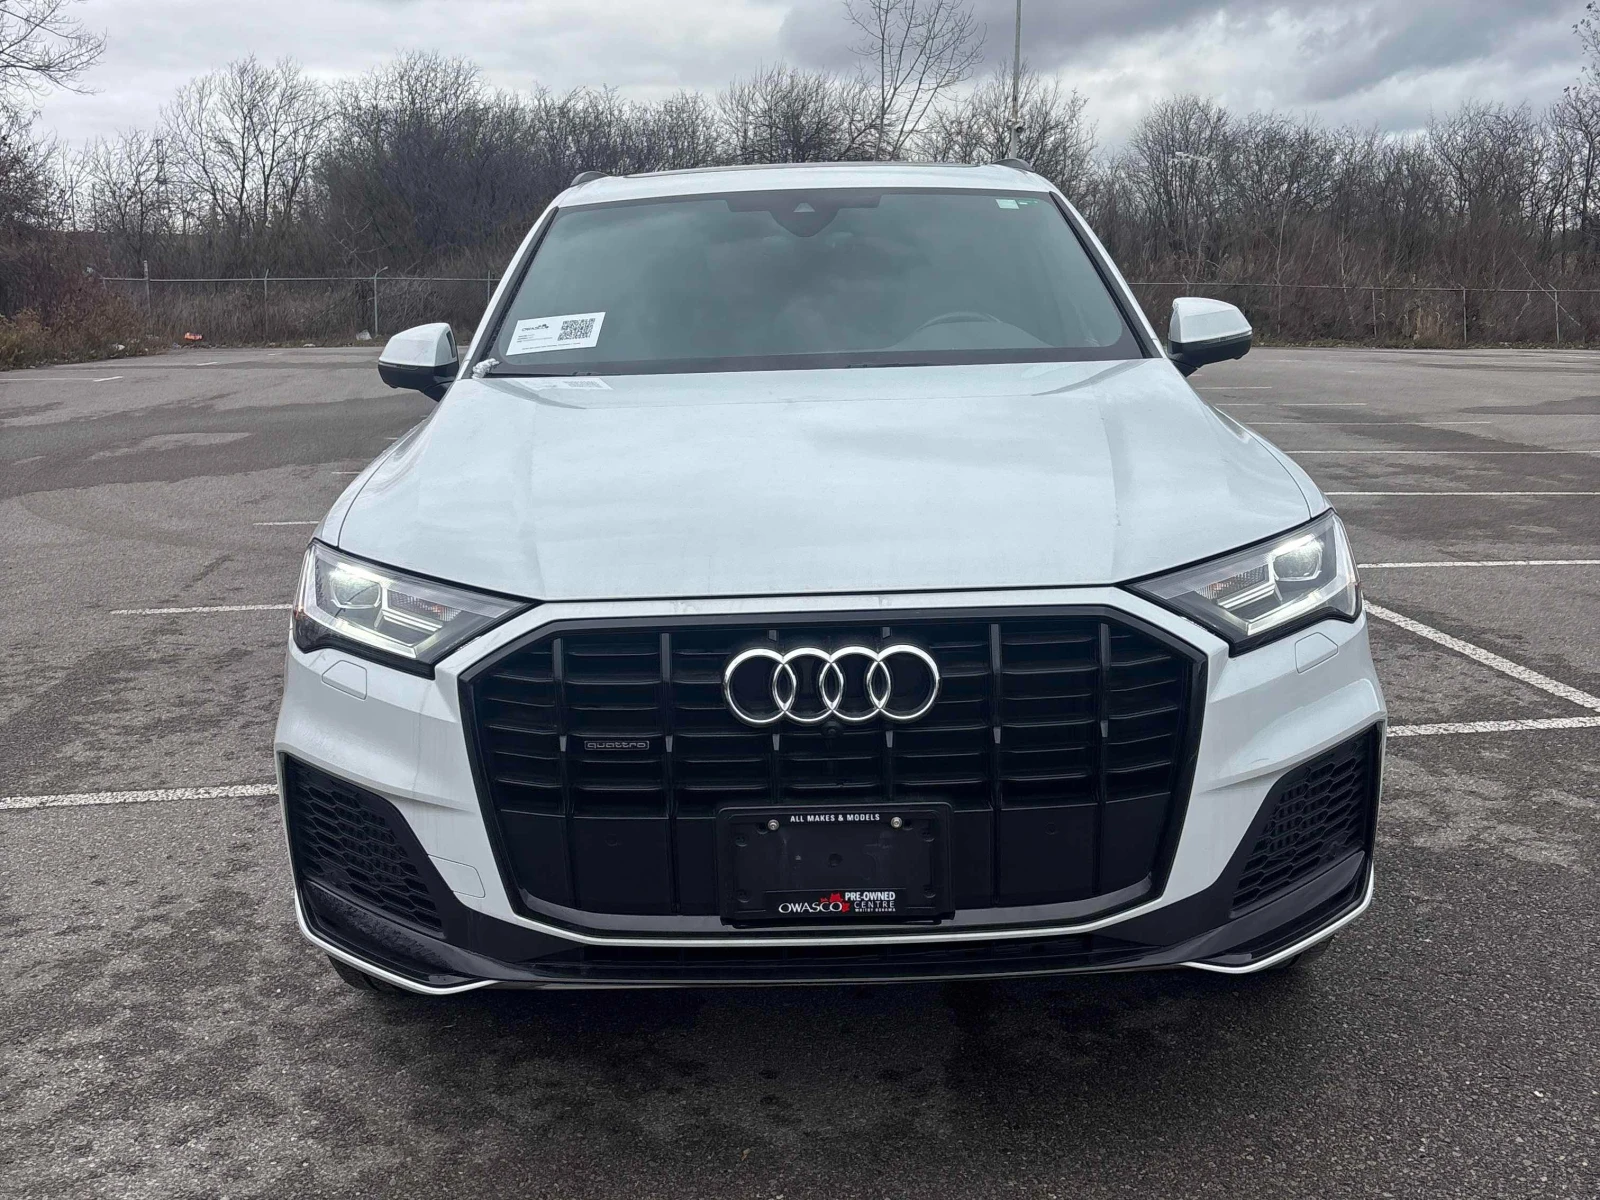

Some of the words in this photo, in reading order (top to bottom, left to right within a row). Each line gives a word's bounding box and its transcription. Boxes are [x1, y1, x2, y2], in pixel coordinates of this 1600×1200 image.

[790, 815, 804, 823] ALL
[807, 814, 835, 822] MAKES
[837, 814, 844, 822] &
[846, 813, 880, 821] MODELS
[845, 892, 895, 901] PRE-OWNED
[778, 902, 843, 913] OWASCO
